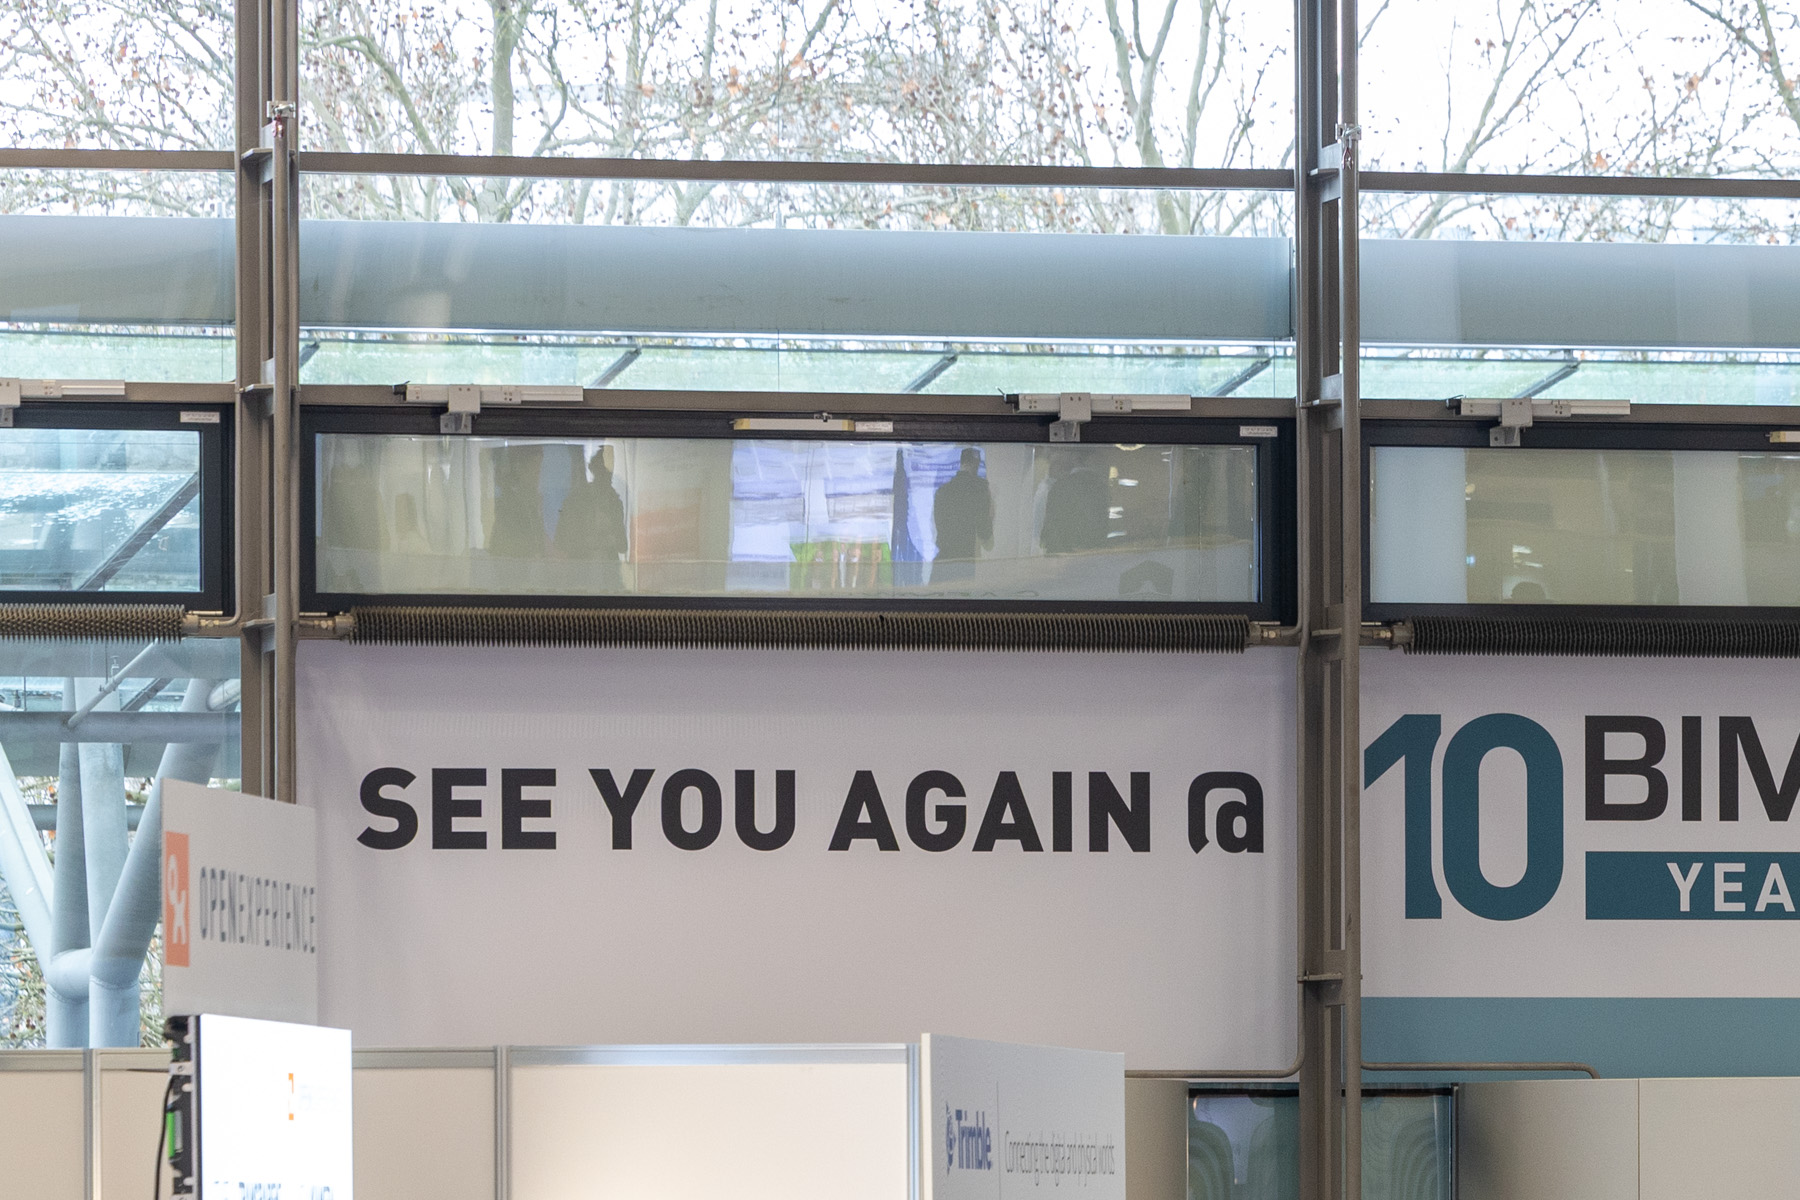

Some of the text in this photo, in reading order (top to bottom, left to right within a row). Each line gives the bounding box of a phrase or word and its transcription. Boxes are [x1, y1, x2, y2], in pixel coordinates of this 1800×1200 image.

[356, 766, 1265, 855] SEE YOU AGAIN @
[1363, 711, 1564, 922] 10
[199, 865, 316, 954] OPENEXPERIENCE
[955, 1109, 992, 1171] Trimble
